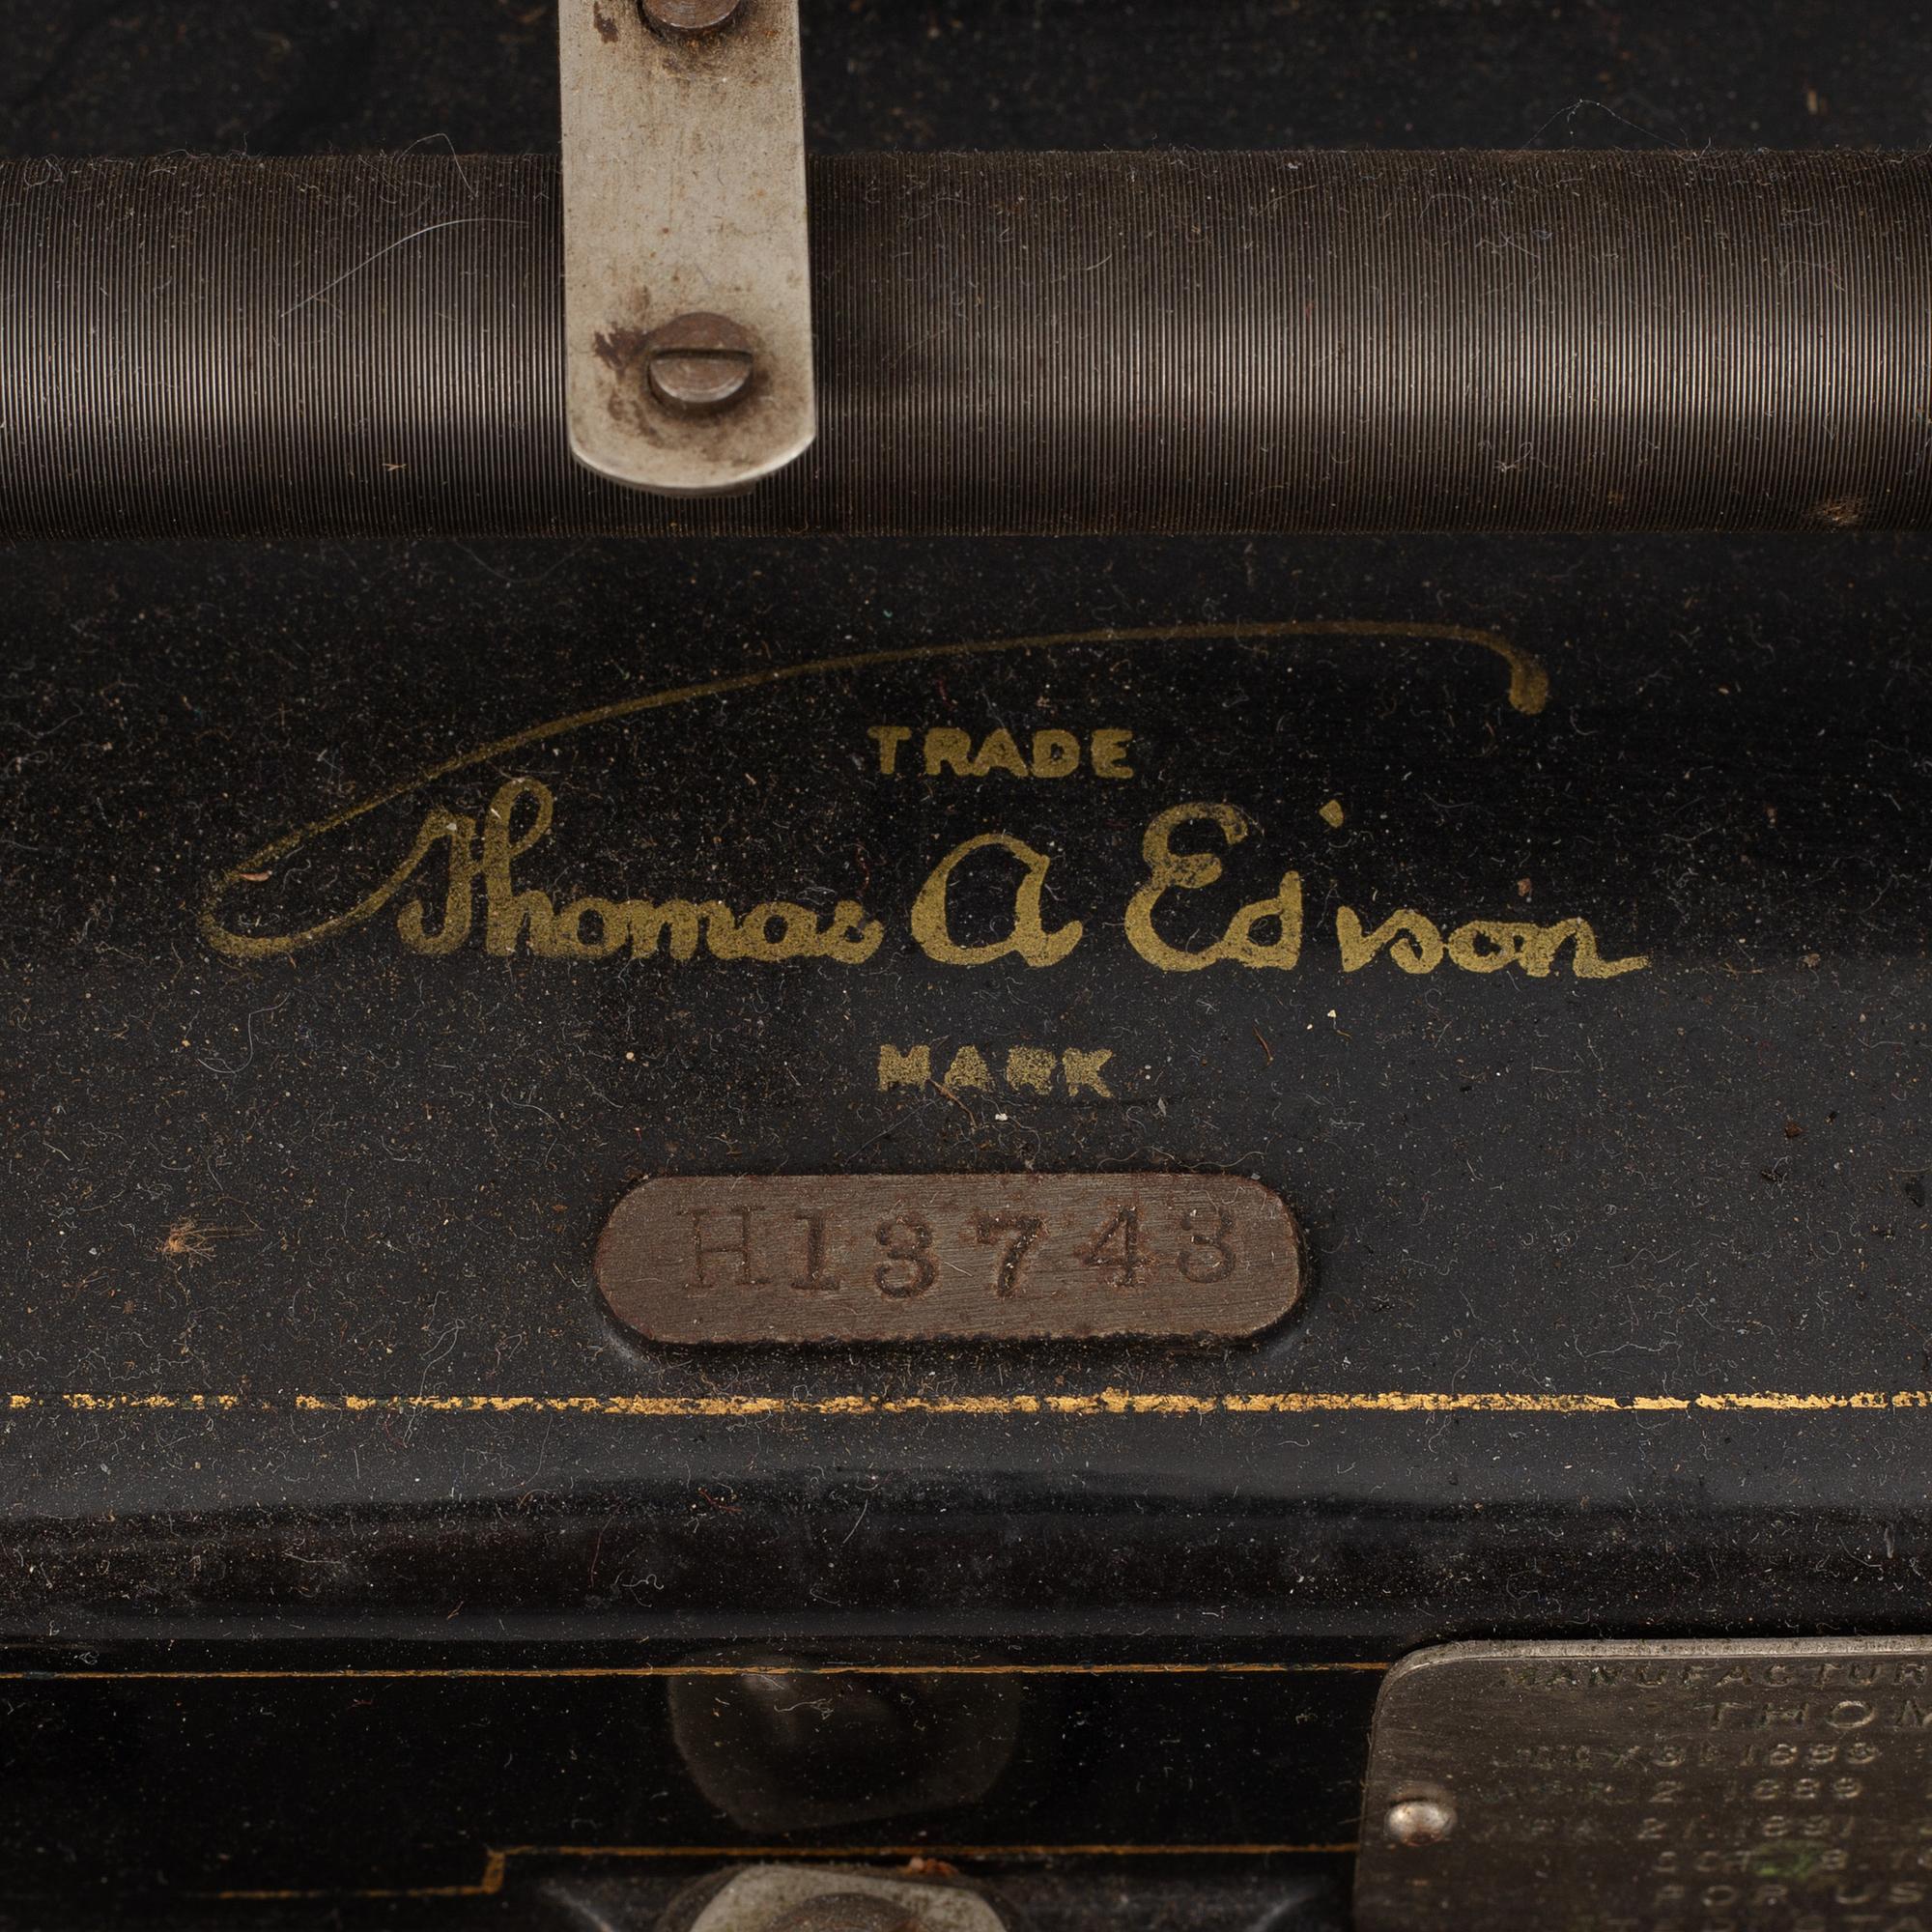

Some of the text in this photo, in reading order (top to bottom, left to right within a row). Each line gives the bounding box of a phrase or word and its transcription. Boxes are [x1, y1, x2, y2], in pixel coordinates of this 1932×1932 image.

[867, 725, 1134, 780] TRADE
[199, 776, 1650, 980] Thomas A Edison
[877, 1043, 1114, 1098] MARK
